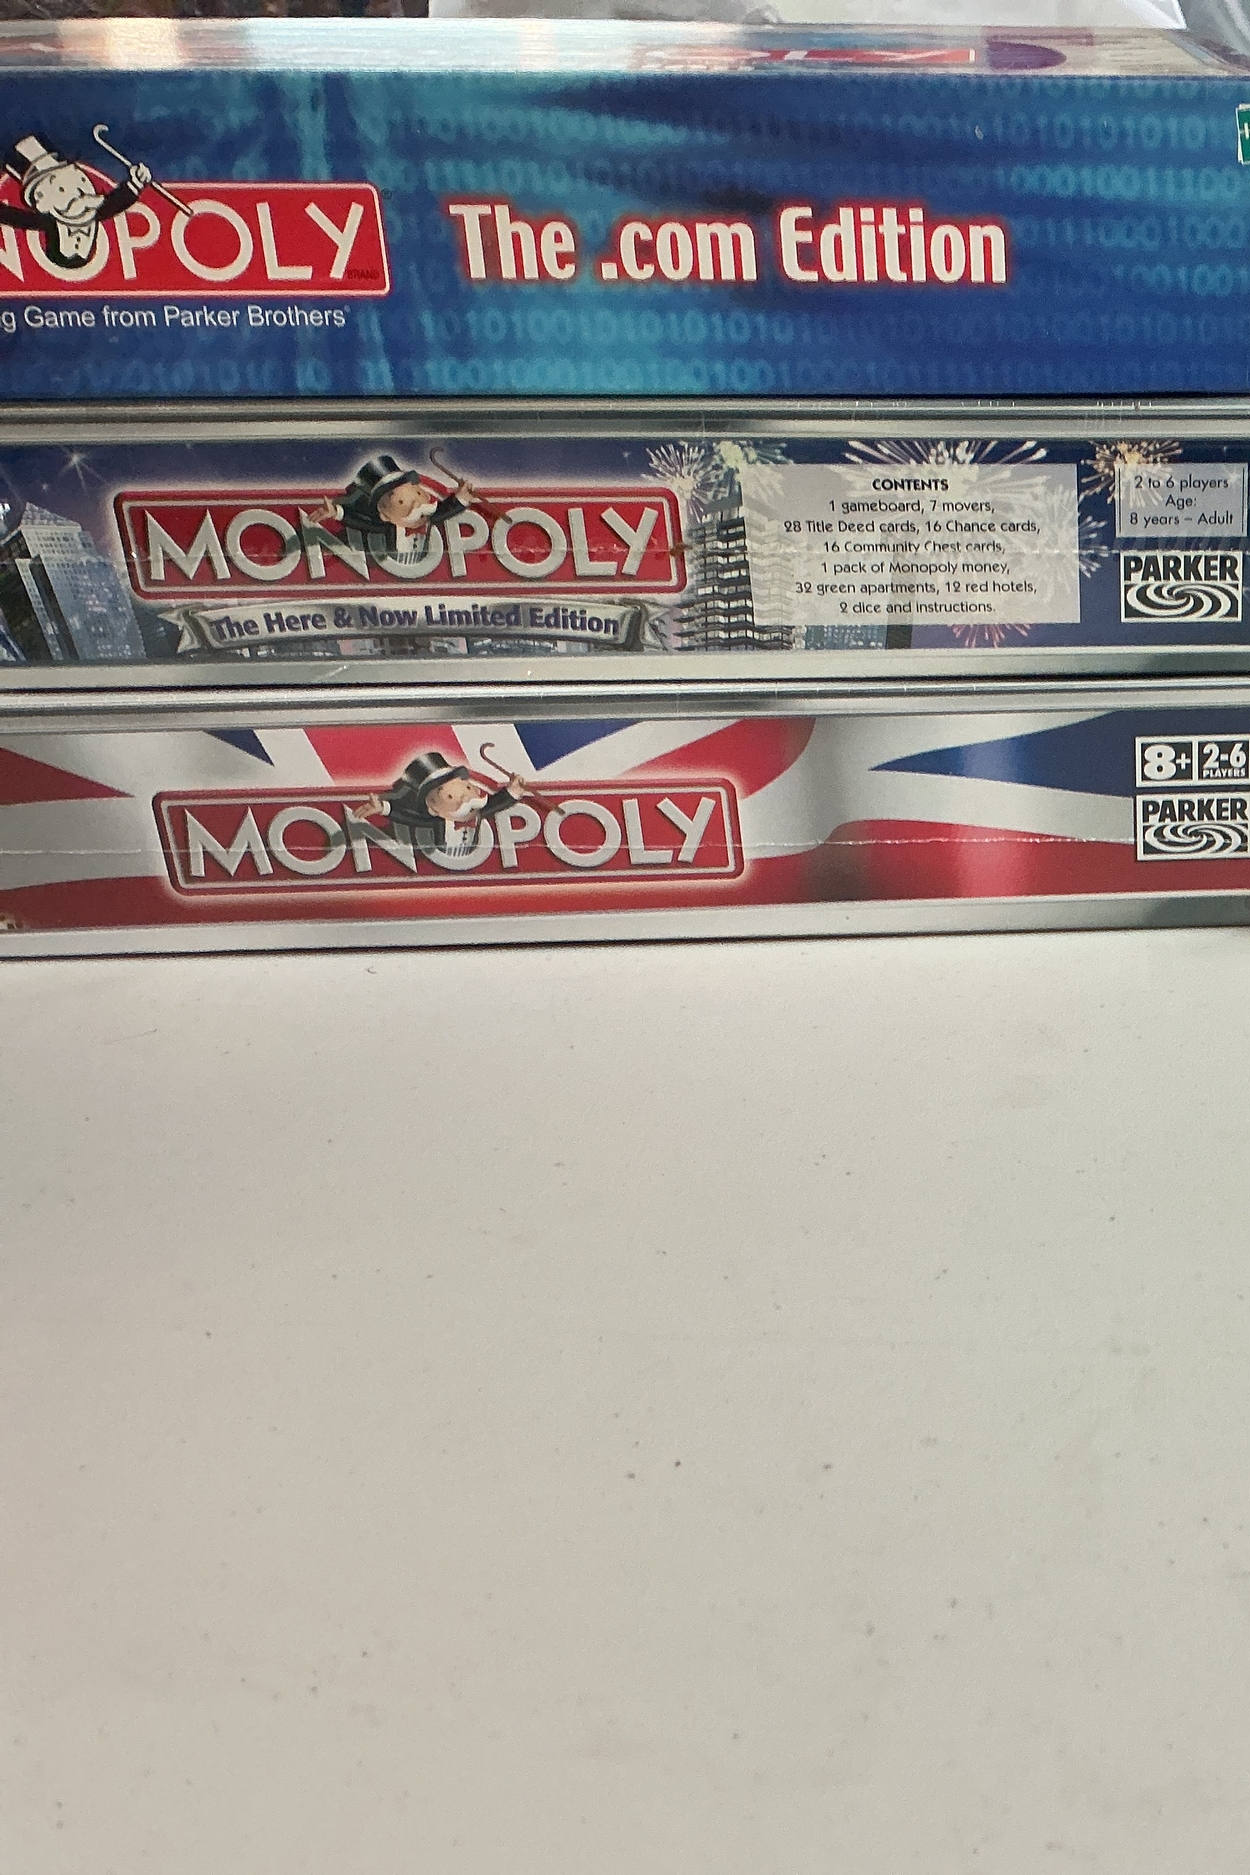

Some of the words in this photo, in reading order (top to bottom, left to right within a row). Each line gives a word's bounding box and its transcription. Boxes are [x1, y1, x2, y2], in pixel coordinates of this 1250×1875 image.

[449, 204, 576, 280] The
[601, 221, 758, 282] .com
[780, 206, 1007, 283] Edition
[24, 305, 96, 329] Game
[104, 305, 157, 328] from
[164, 306, 240, 328] Parker
[247, 306, 346, 328] Brothers
[872, 478, 949, 491] CONTENTS
[1134, 476, 1143, 489] 2
[1148, 476, 1161, 488] to
[1166, 475, 1175, 488] 6
[1180, 474, 1229, 492] players
[829, 500, 835, 512] 1
[841, 499, 924, 514] gameboard,
[930, 500, 937, 512] 7
[943, 501, 995, 514] movers,
[1165, 494, 1197, 509] Age:
[784, 520, 802, 532] 28
[806, 520, 833, 532] Title
[838, 520, 875, 532] Deed
[880, 520, 920, 535] cards,
[925, 520, 942, 532] 16
[946, 520, 996, 532] Chance
[1000, 520, 1041, 535] cards,
[1130, 512, 1138, 525] 8
[1143, 513, 1180, 528] years
[1197, 510, 1233, 524] Adult
[145, 505, 659, 582] MONOPOLY
[824, 541, 840, 552] 16
[844, 540, 920, 555] Community
[924, 540, 961, 553] Chest
[966, 541, 1006, 555] cards,
[821, 562, 828, 573] 1
[834, 562, 867, 575] pack
[871, 562, 885, 573] of
[889, 561, 958, 575] Monopoly
[962, 562, 1010, 575] money,
[1124, 555, 1240, 581] PARKER
[795, 581, 812, 593] 32
[817, 583, 856, 595] green
[860, 581, 940, 595] apartments,
[945, 581, 961, 592] 12
[966, 581, 988, 592] red
[993, 580, 1037, 594] hotels,
[840, 602, 848, 613] 2
[852, 601, 881, 613] dice
[886, 602, 912, 613] and
[916, 601, 996, 613] instructions.
[211, 614, 260, 641] The
[264, 610, 327, 635] Here
[334, 608, 354, 629] &
[359, 606, 418, 628] Now
[425, 603, 522, 629] Limited
[529, 607, 621, 636] Edition
[1143, 744, 1191, 780] 8+
[1203, 742, 1247, 768] 2-6
[1202, 767, 1246, 779] PLAYERS
[1142, 798, 1249, 822] PARKER
[184, 796, 717, 878] MONOPOLY
